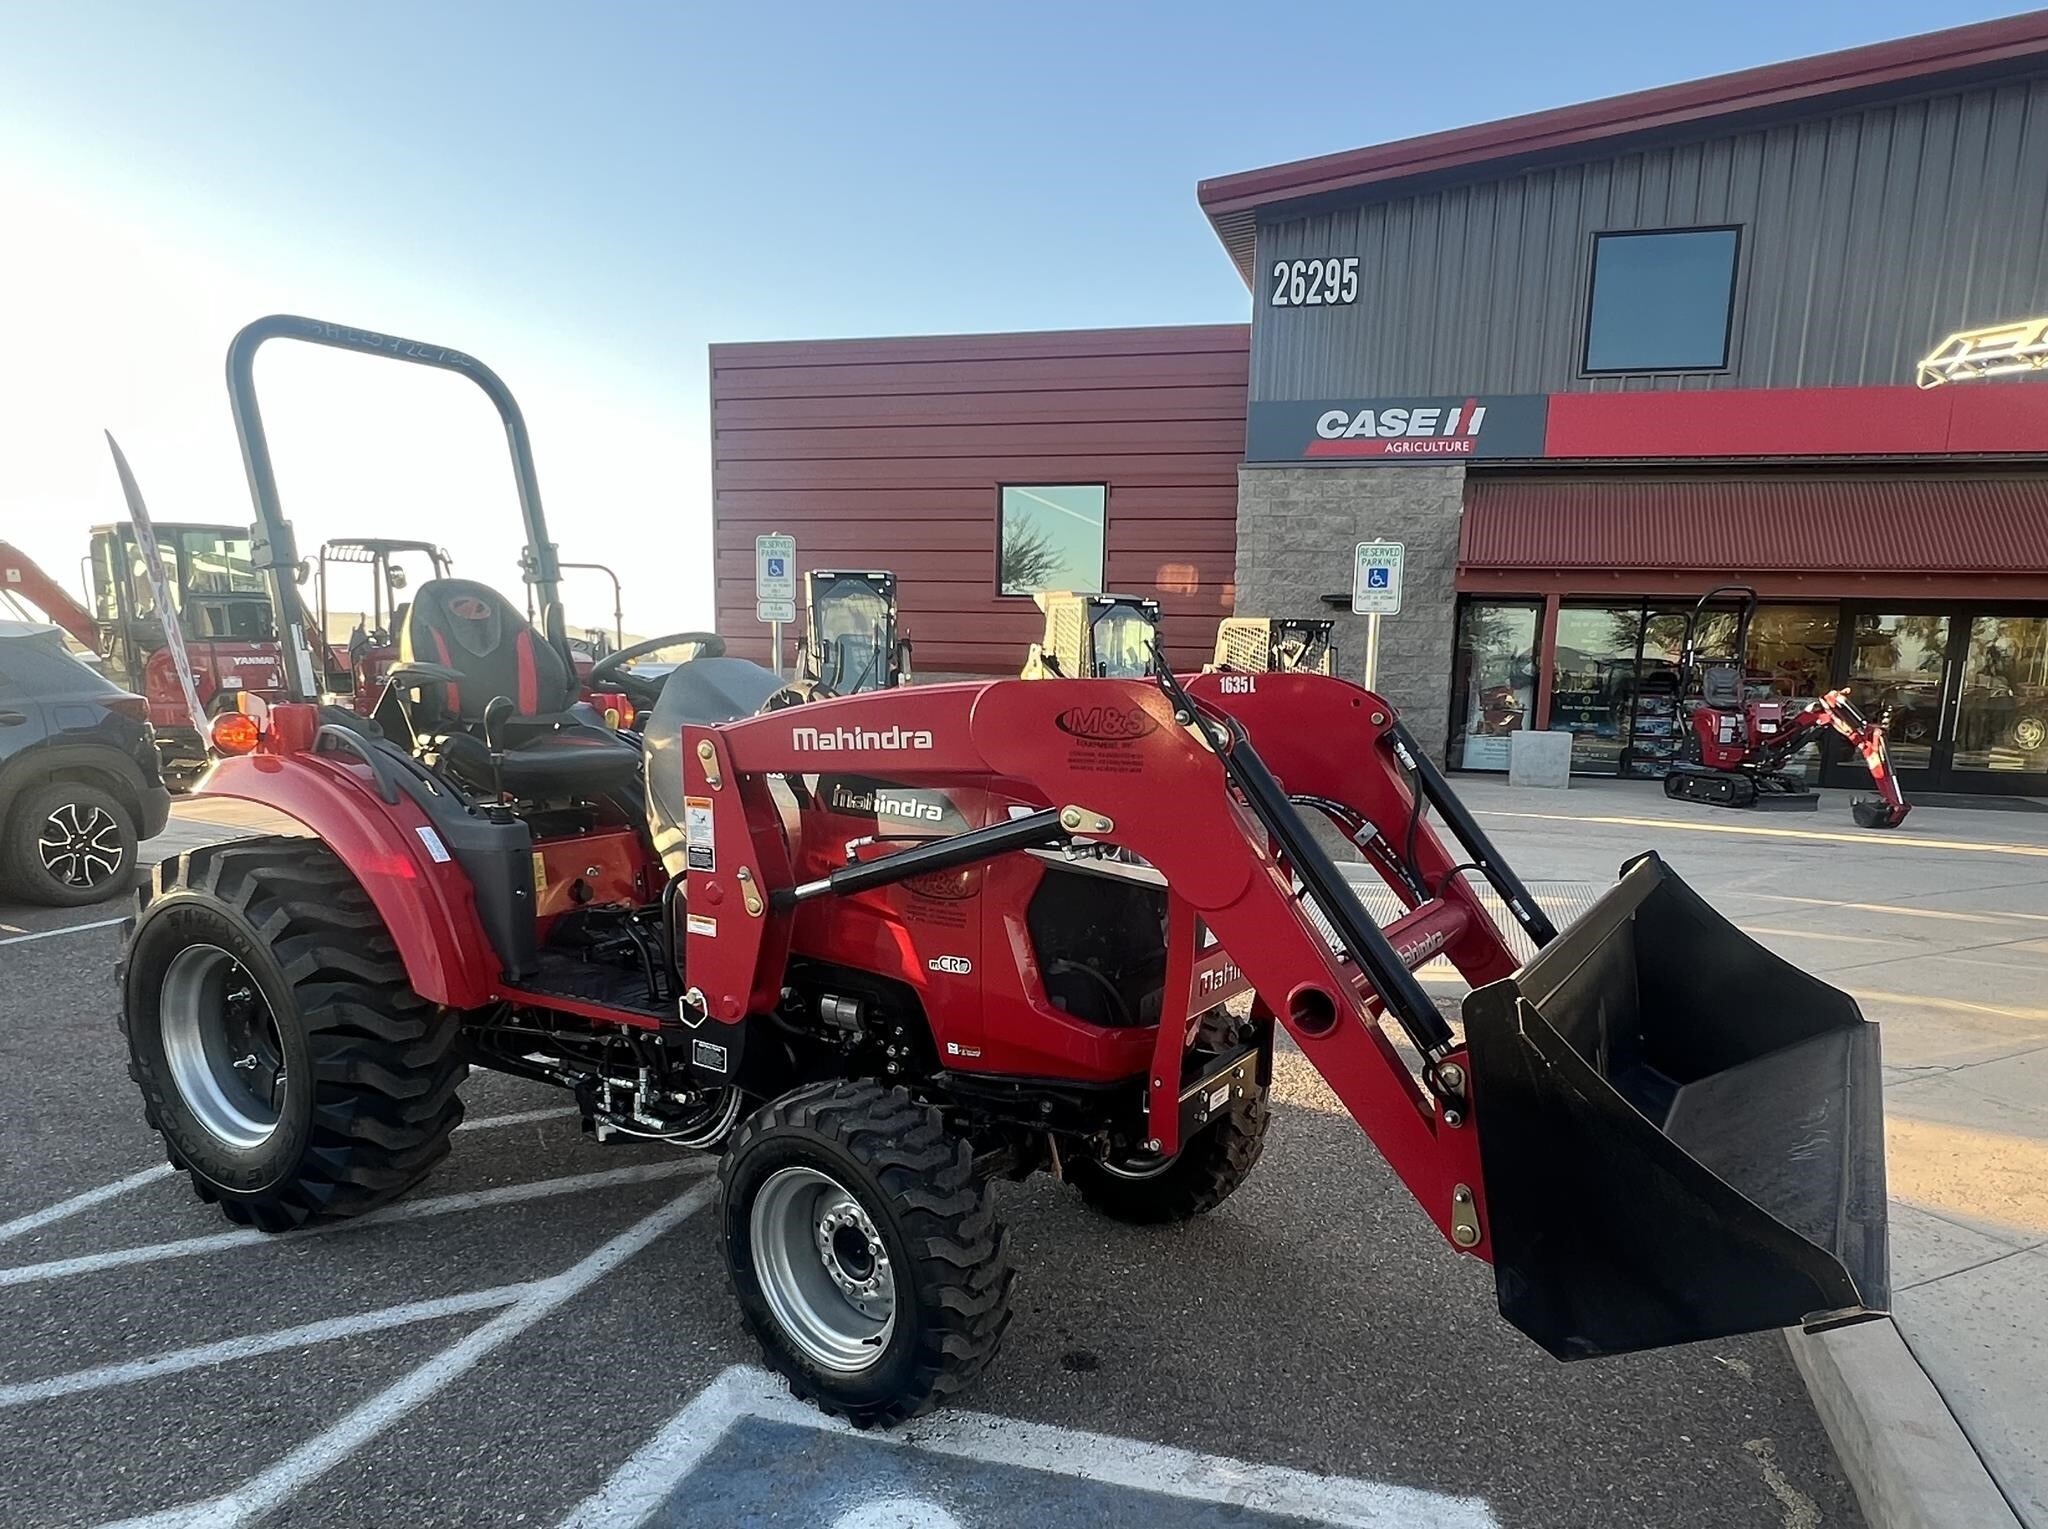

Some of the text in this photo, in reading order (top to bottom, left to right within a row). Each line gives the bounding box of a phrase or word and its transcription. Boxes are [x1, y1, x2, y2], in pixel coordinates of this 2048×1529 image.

[1271, 257, 1359, 306] 26295
[1316, 408, 1441, 439] CASE
[1384, 441, 1470, 453] AGRICULTURE
[1360, 547, 1400, 557] RESERVED
[1361, 557, 1398, 567] PARKING
[1071, 706, 1146, 736] M&S
[792, 725, 934, 751] Mahindra
[832, 787, 944, 822] Mahindra
[1397, 930, 1444, 965] ahindra
